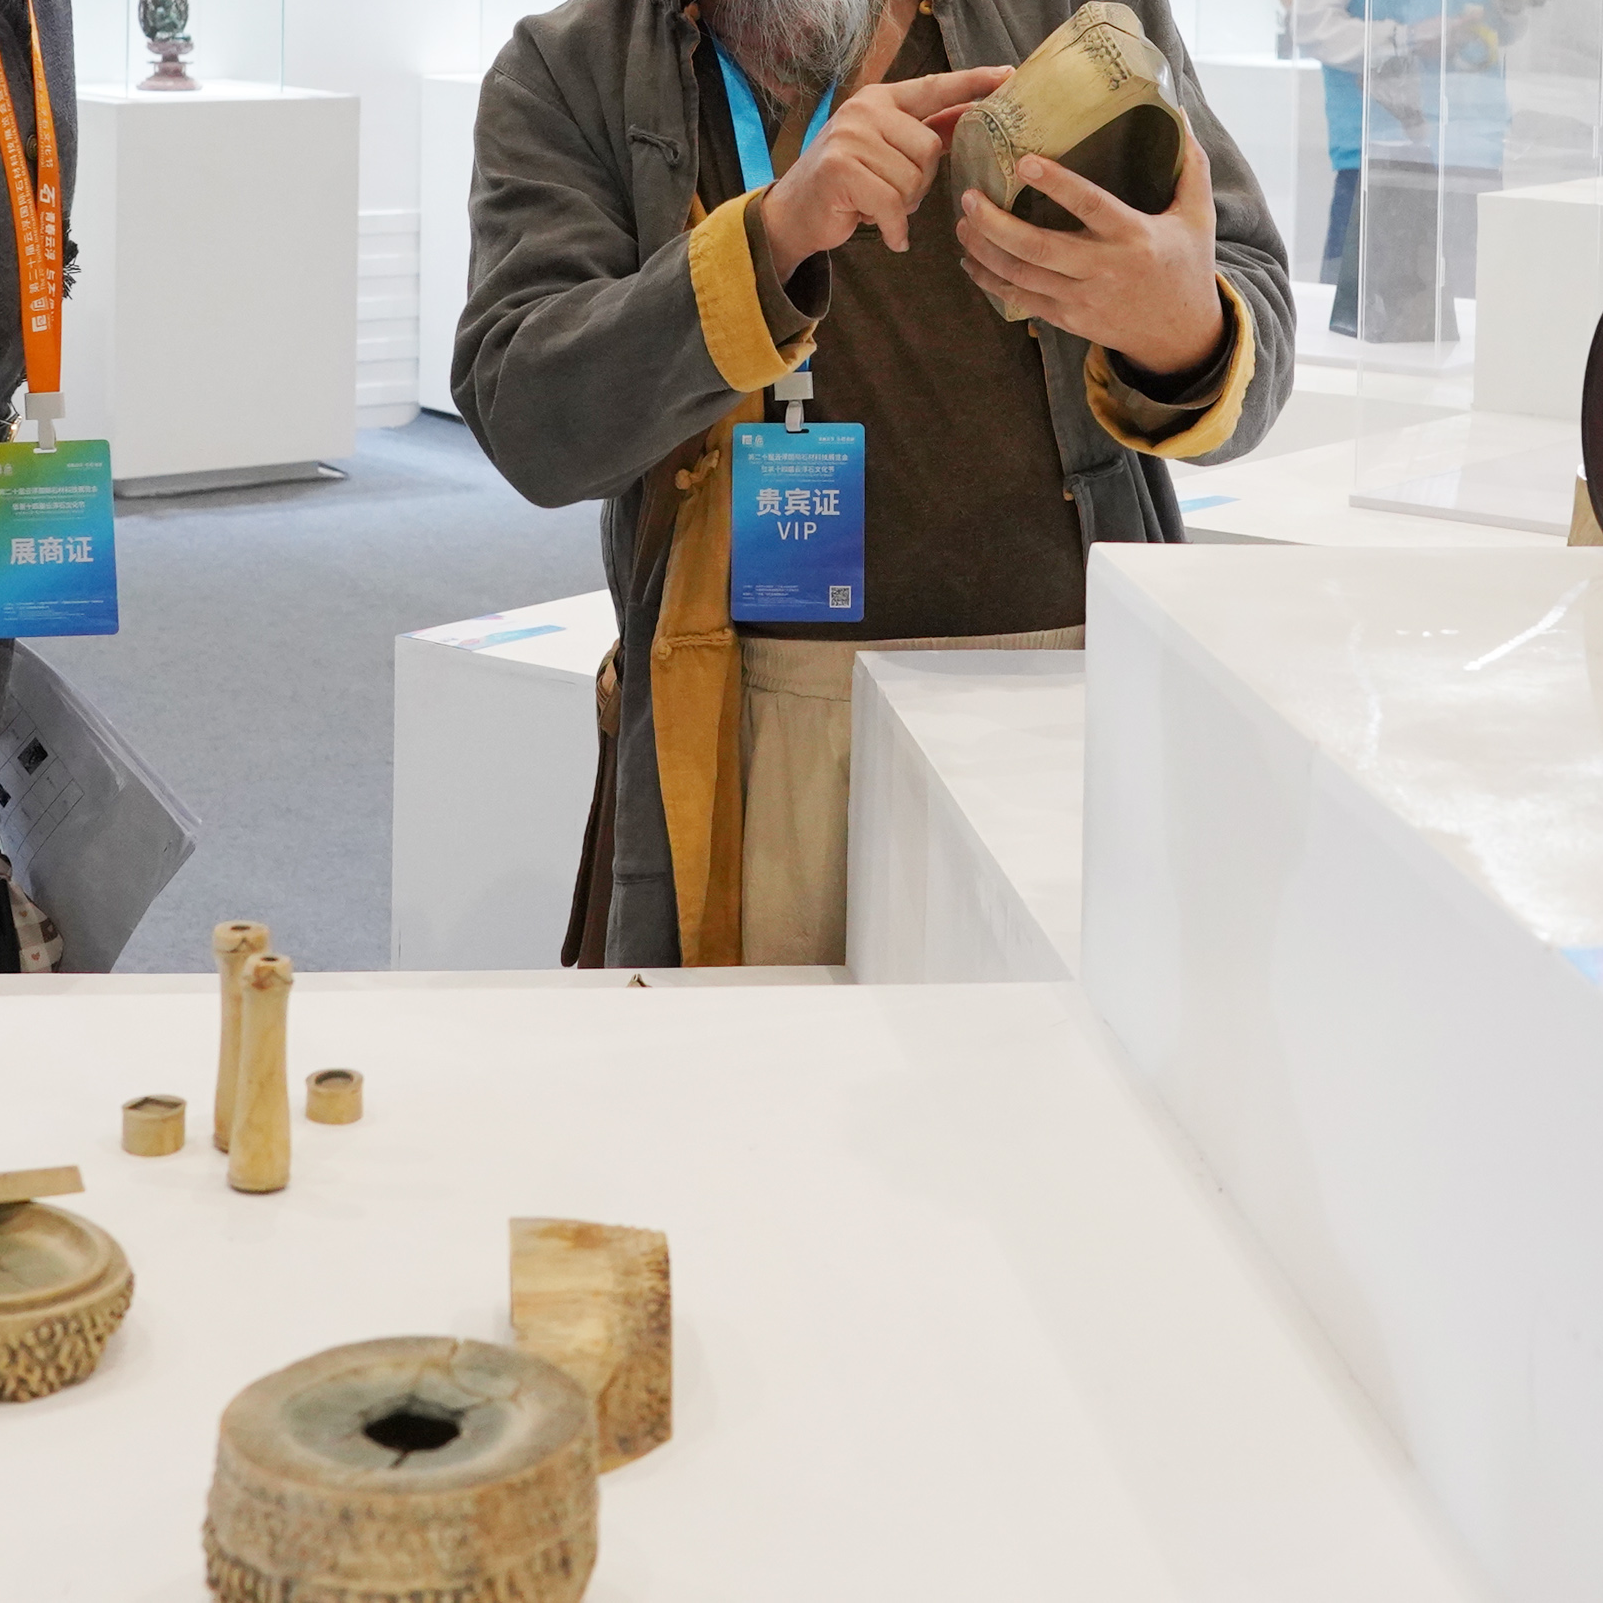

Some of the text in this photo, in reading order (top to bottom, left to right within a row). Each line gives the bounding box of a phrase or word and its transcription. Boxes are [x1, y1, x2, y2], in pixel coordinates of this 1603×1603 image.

[26, 197, 39, 243] International
[44, 211, 55, 260] 青春云浮
[756, 488, 840, 516] 贵宾证
[777, 521, 817, 540] VIP
[10, 536, 94, 565] 展商证
